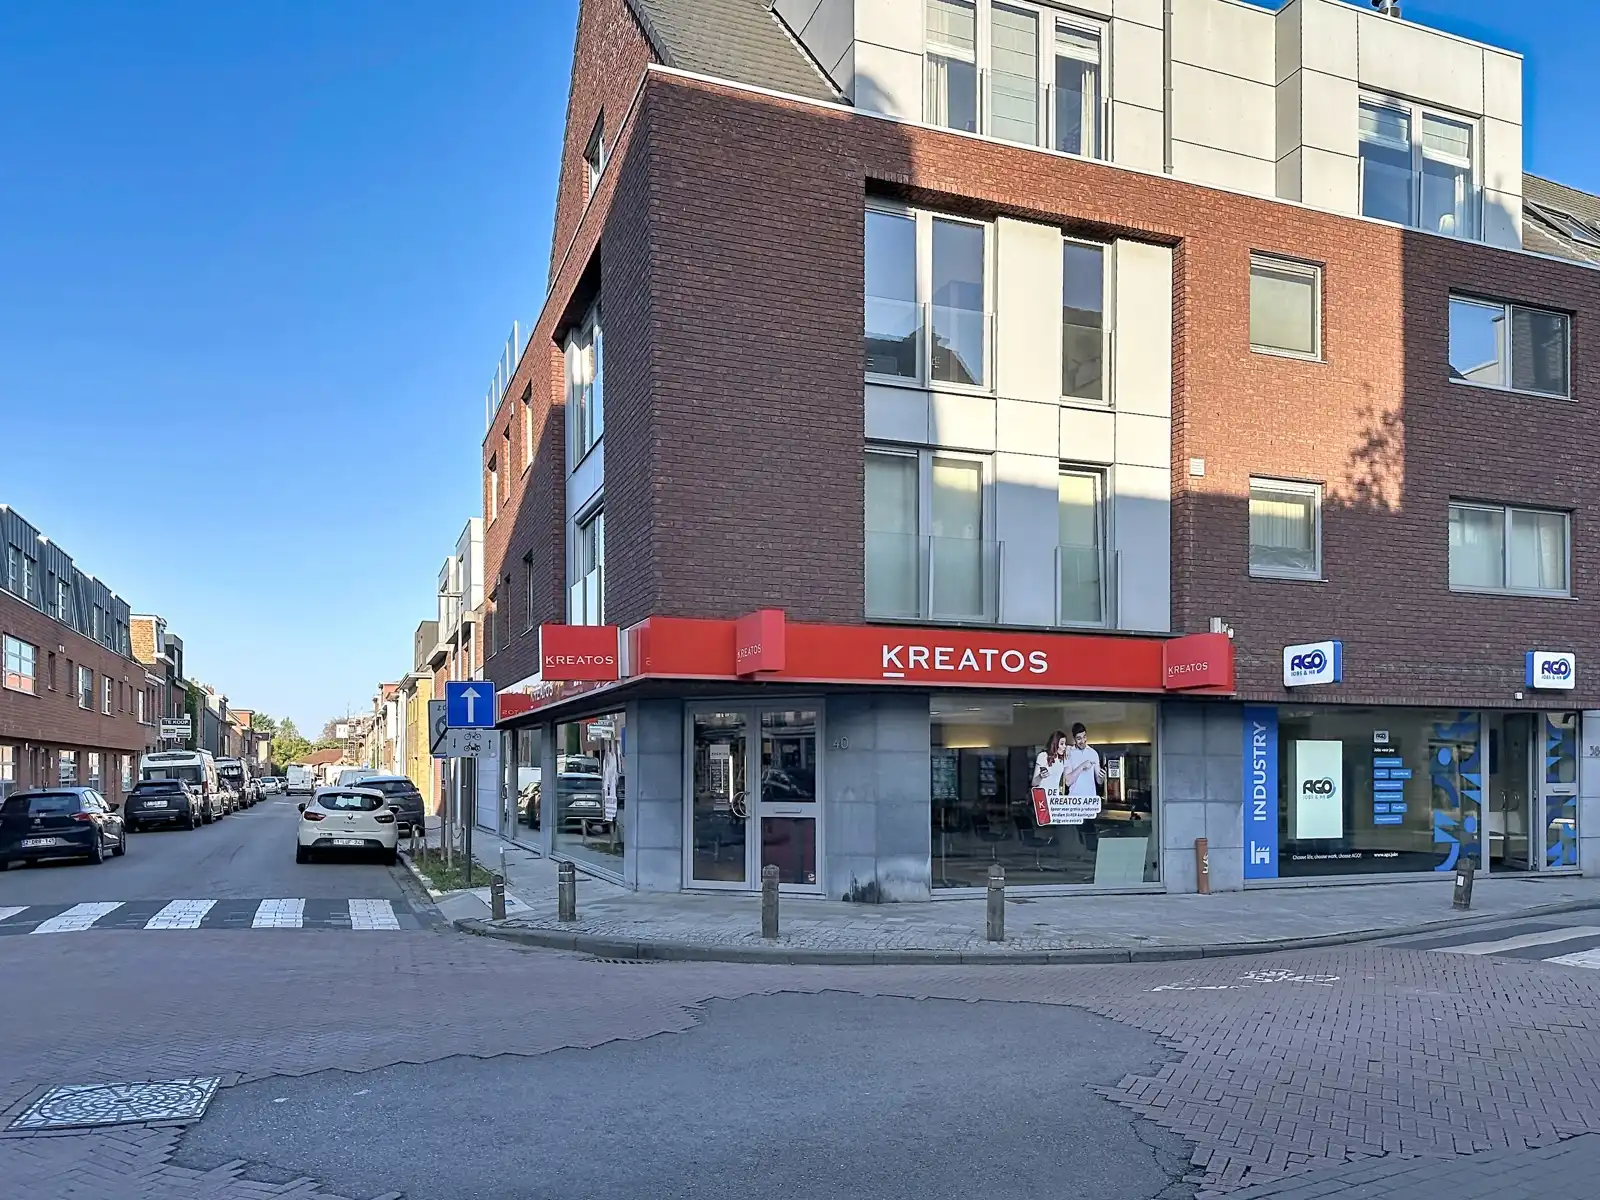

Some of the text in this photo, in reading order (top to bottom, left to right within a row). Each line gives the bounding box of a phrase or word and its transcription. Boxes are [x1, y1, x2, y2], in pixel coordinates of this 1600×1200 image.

[737, 643, 762, 662] KREATOS
[882, 644, 1049, 677] KREATOS
[1291, 650, 1325, 671] AGO
[545, 655, 614, 668] KREATOS
[1168, 662, 1208, 677] KREATOS
[1541, 659, 1569, 675] AGO
[833, 736, 849, 749] 40
[1253, 720, 1267, 821] INDUSTRY
[1303, 778, 1333, 795] AGO
[1038, 800, 1046, 811] K
